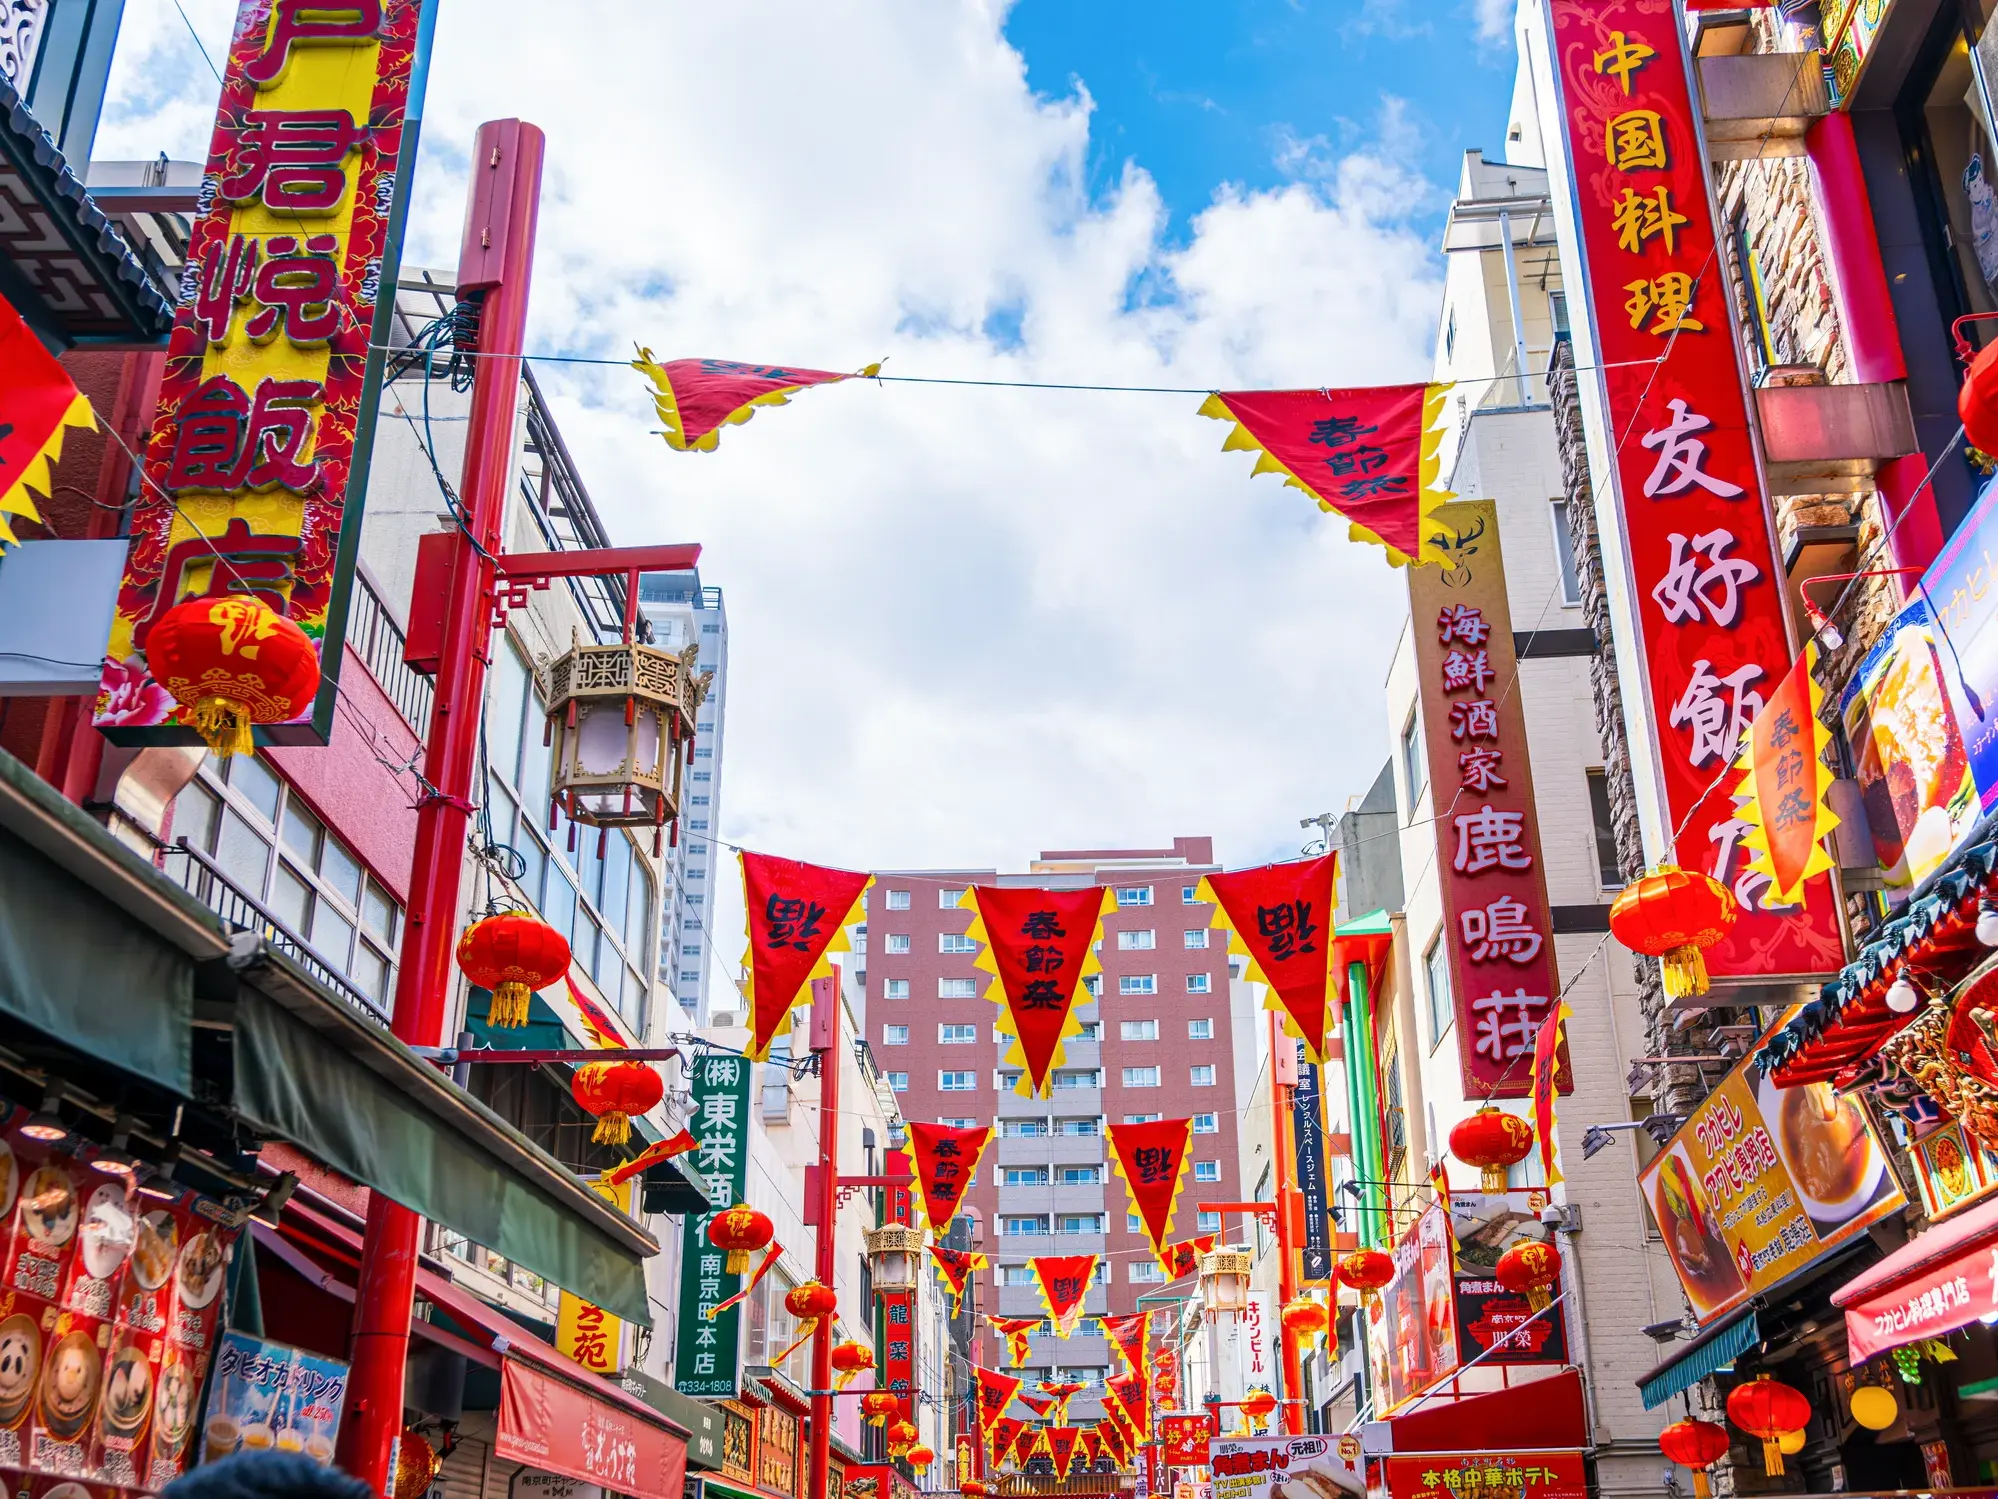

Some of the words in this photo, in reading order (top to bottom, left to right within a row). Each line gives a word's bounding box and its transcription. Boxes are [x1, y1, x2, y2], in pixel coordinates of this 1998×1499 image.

[1593, 31, 1704, 336] 中国料理
[1309, 416, 1408, 500] 春節祭
[1439, 605, 1508, 793] 海鮮酒家
[1770, 708, 1812, 832] 春節祭
[1021, 910, 1066, 1011] 春節祭
[1695, 1094, 1743, 1160] フカヒレ
[931, 1140, 961, 1200] 春節祭
[1703, 1126, 1778, 1211] アワビ専門店
[694, 1253, 722, 1375] 南京町本店
[1459, 1281, 1504, 1294] 角煮まん
[1873, 1275, 1970, 1337] フカヒレ料理専門店
[1248, 1301, 1264, 1373] キリンビール
[220, 1346, 344, 1404] タピオカドリンク
[686, 1380, 732, 1393] 334-1808
[1212, 1448, 1289, 1477] 角煮まん
[1341, 1447, 1357, 1455] No.1
[1421, 1466, 1559, 1489] 本格中華ポテト
